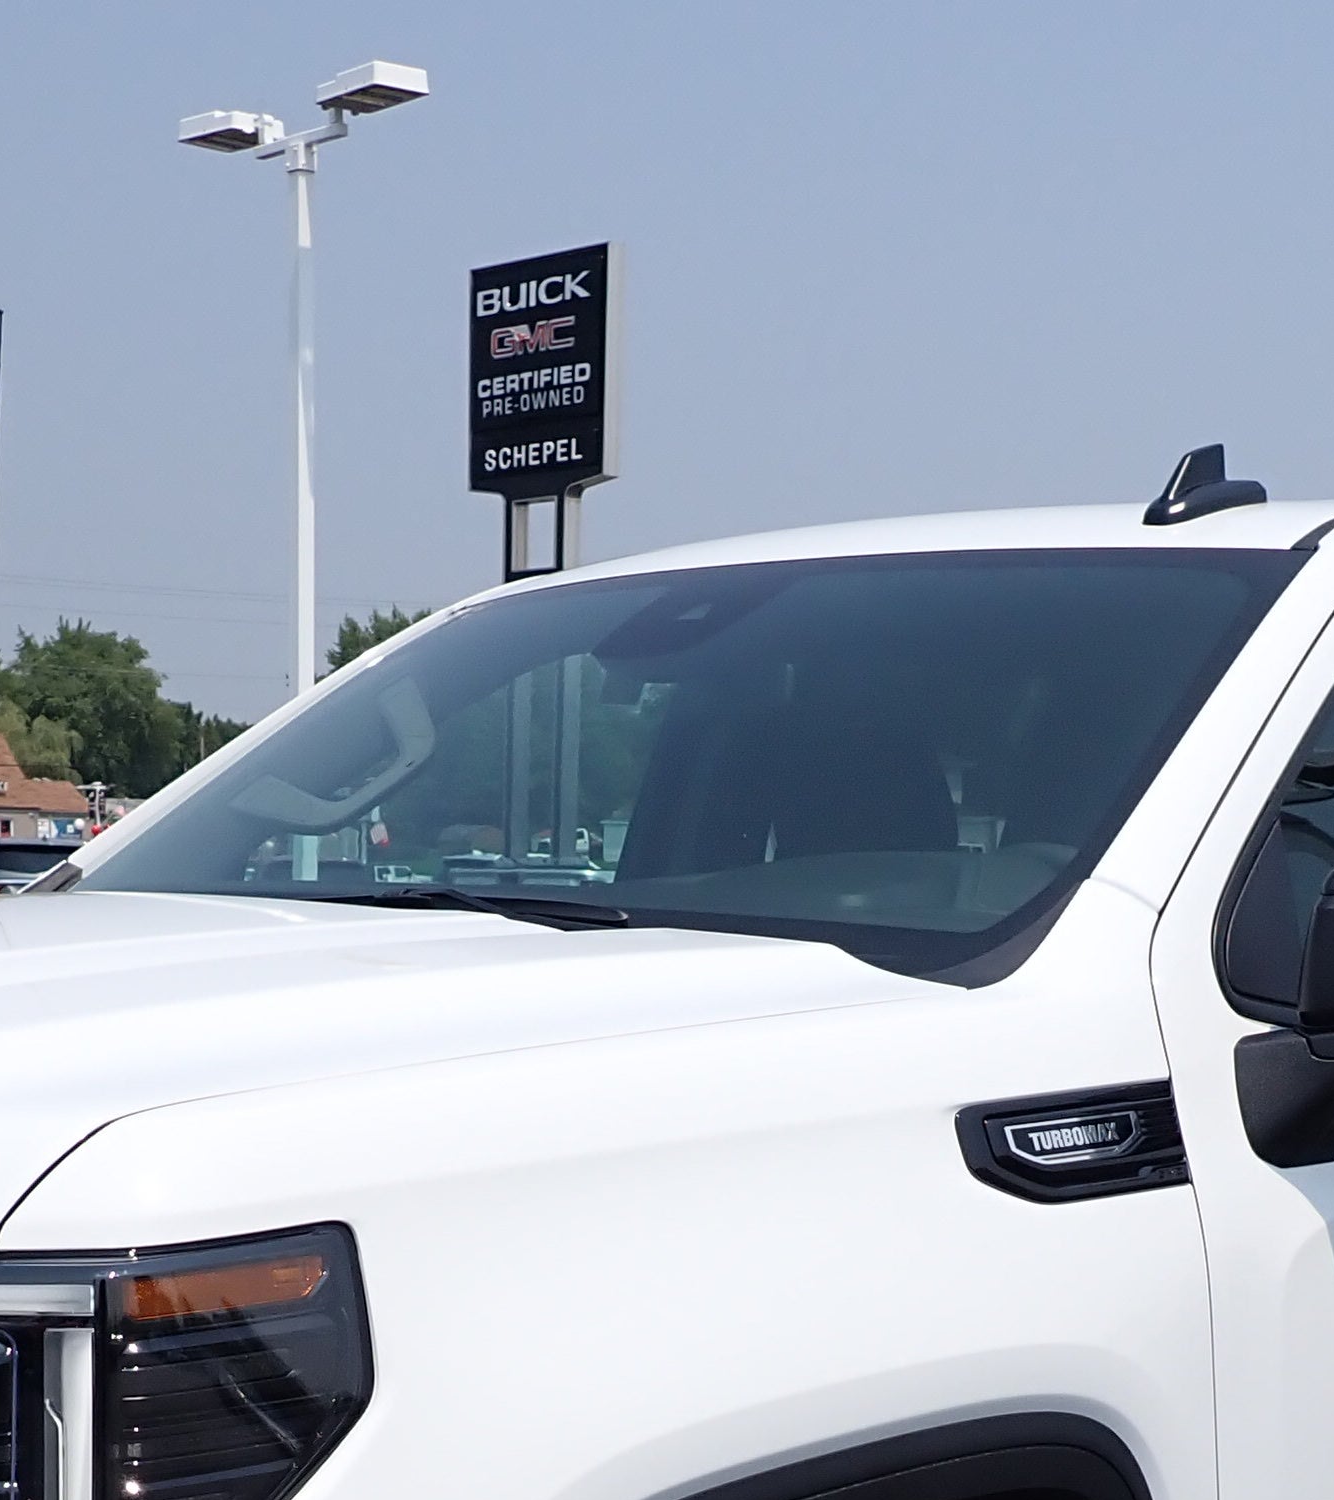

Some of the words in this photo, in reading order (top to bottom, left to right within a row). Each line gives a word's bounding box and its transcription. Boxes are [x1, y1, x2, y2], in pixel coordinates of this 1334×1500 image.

[476, 270, 591, 317] BUICK
[490, 315, 576, 359] GMC
[477, 362, 591, 399] CERTIFIED
[482, 385, 584, 418] PRE-OWNED
[484, 437, 583, 471] SCHEPEL
[1028, 1121, 1120, 1151] TURBOMAX
